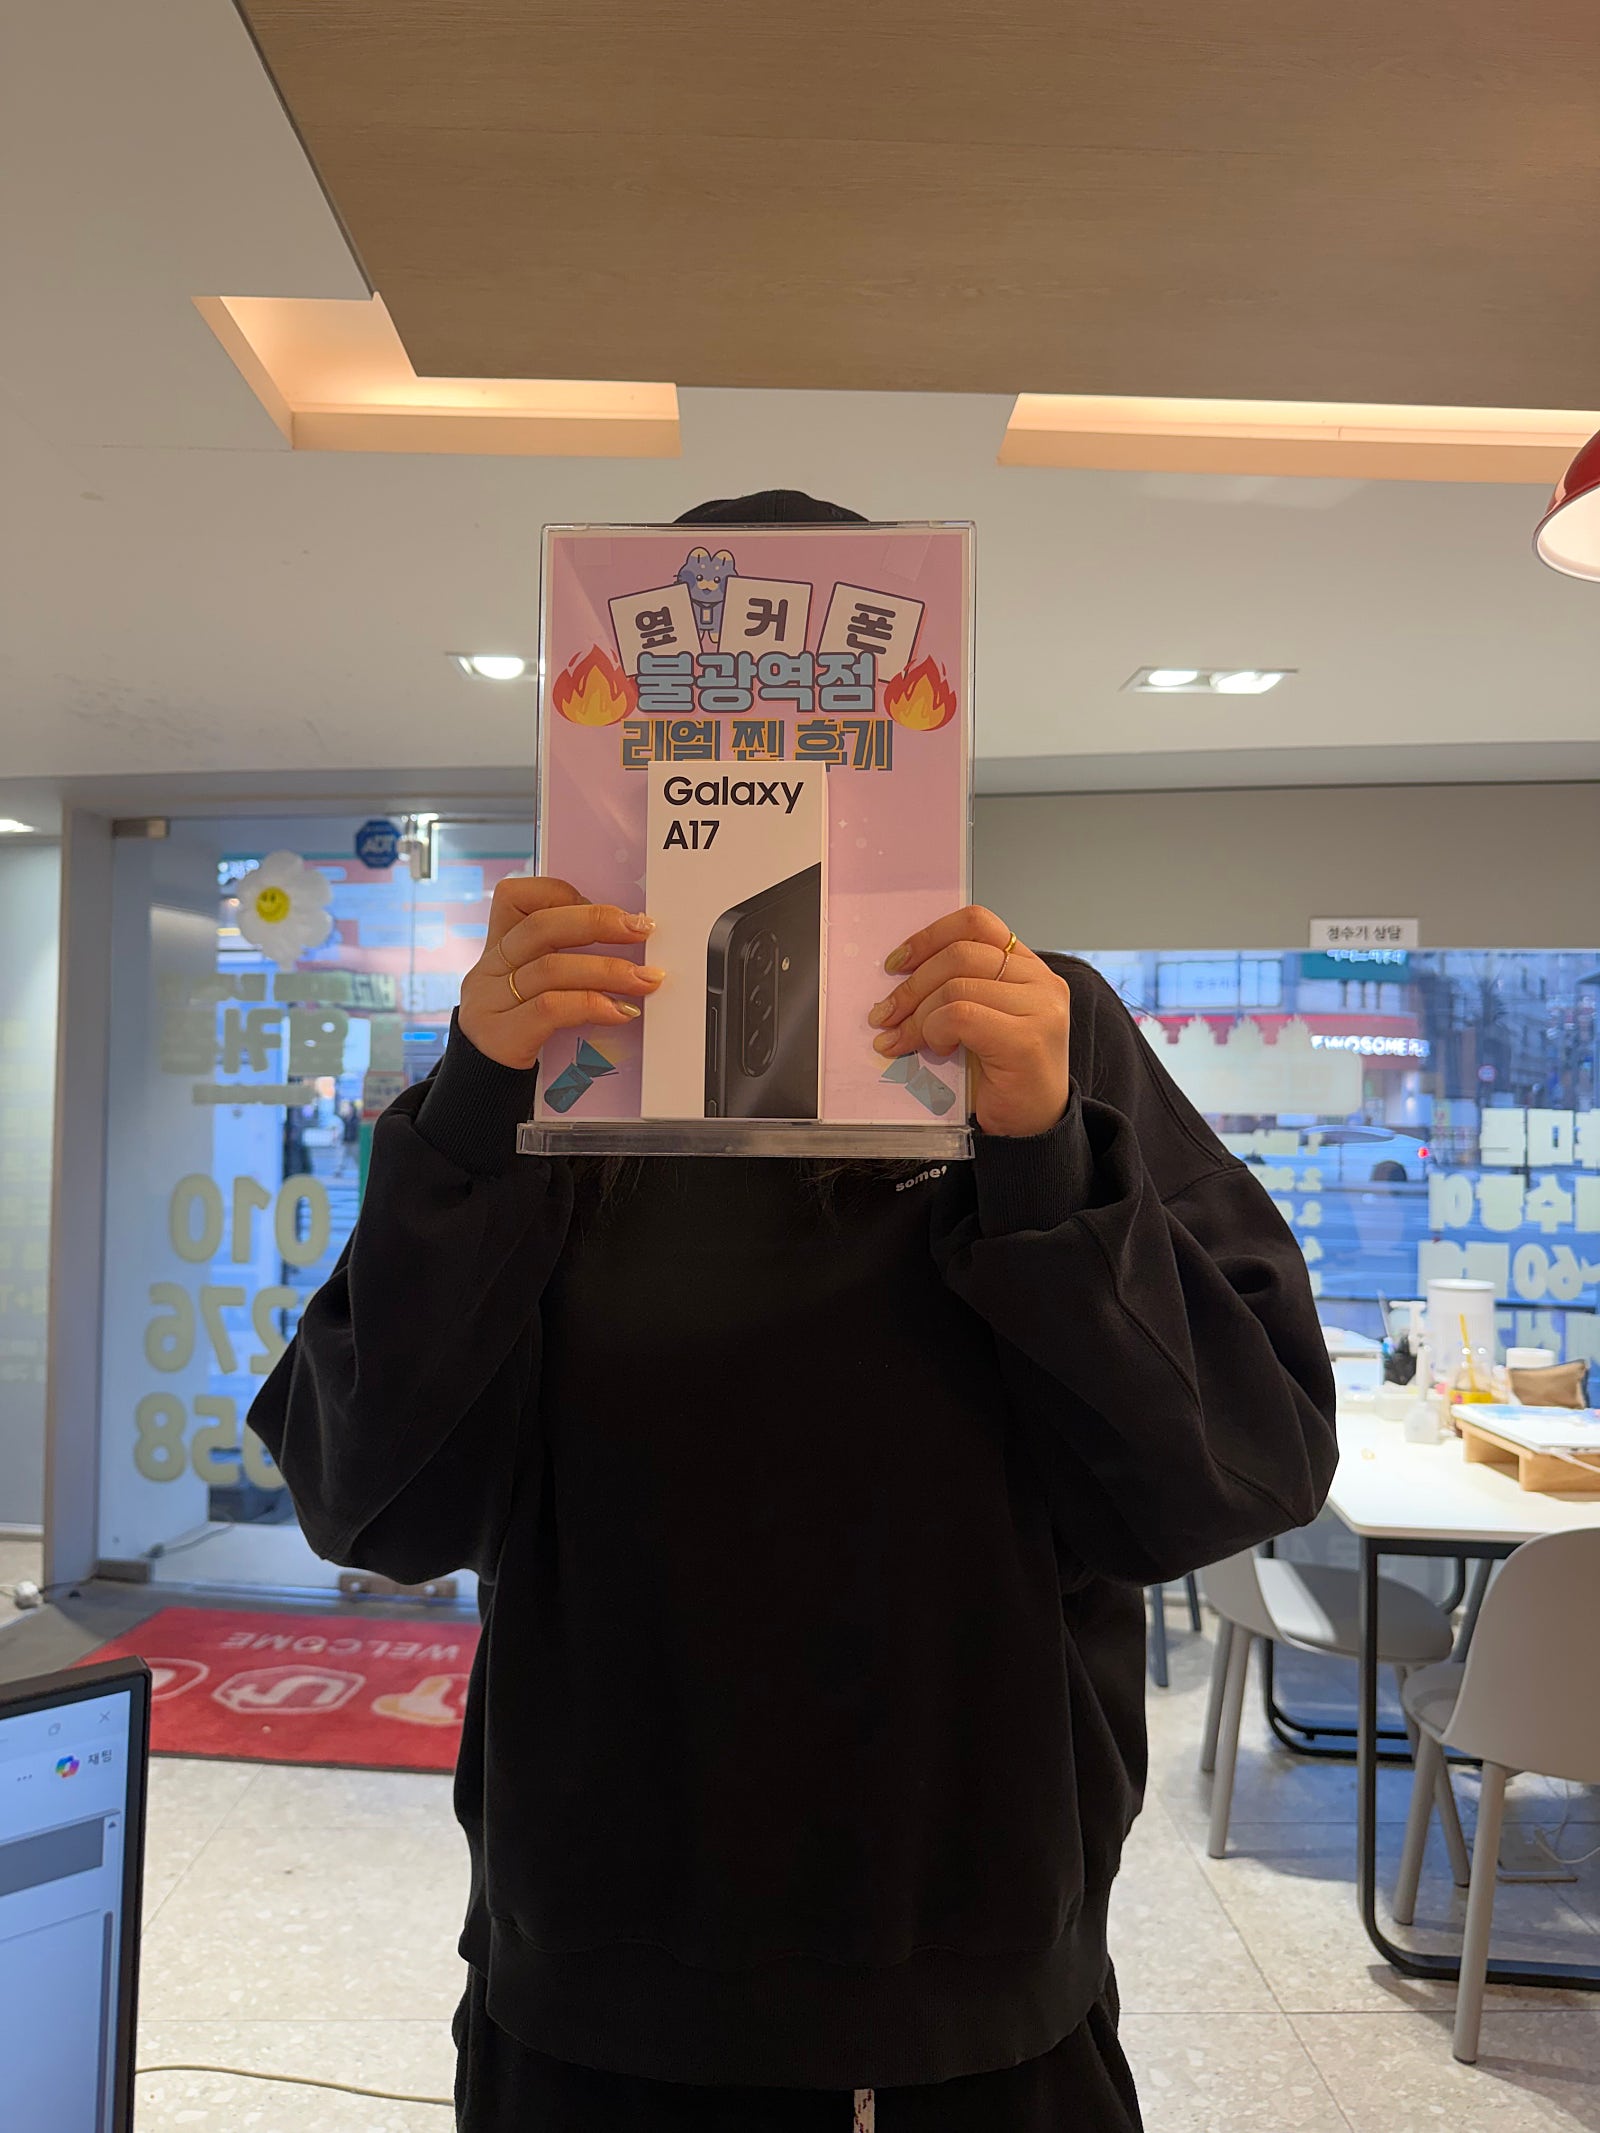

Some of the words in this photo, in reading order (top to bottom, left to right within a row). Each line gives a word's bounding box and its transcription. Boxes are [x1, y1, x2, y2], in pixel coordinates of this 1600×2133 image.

[635, 606, 677, 649] 옆
[744, 598, 788, 642] 커
[846, 602, 897, 655] 폰
[636, 651, 876, 712] 불광역점
[621, 719, 720, 771] 리얼
[731, 719, 784, 762] 찐
[794, 718, 893, 771] 후기
[663, 776, 804, 814] Galaxy
[663, 819, 720, 851] A17
[1326, 925, 1368, 942] 정수기
[1373, 925, 1401, 941] 상담
[221, 1632, 459, 1661] WELCOME
